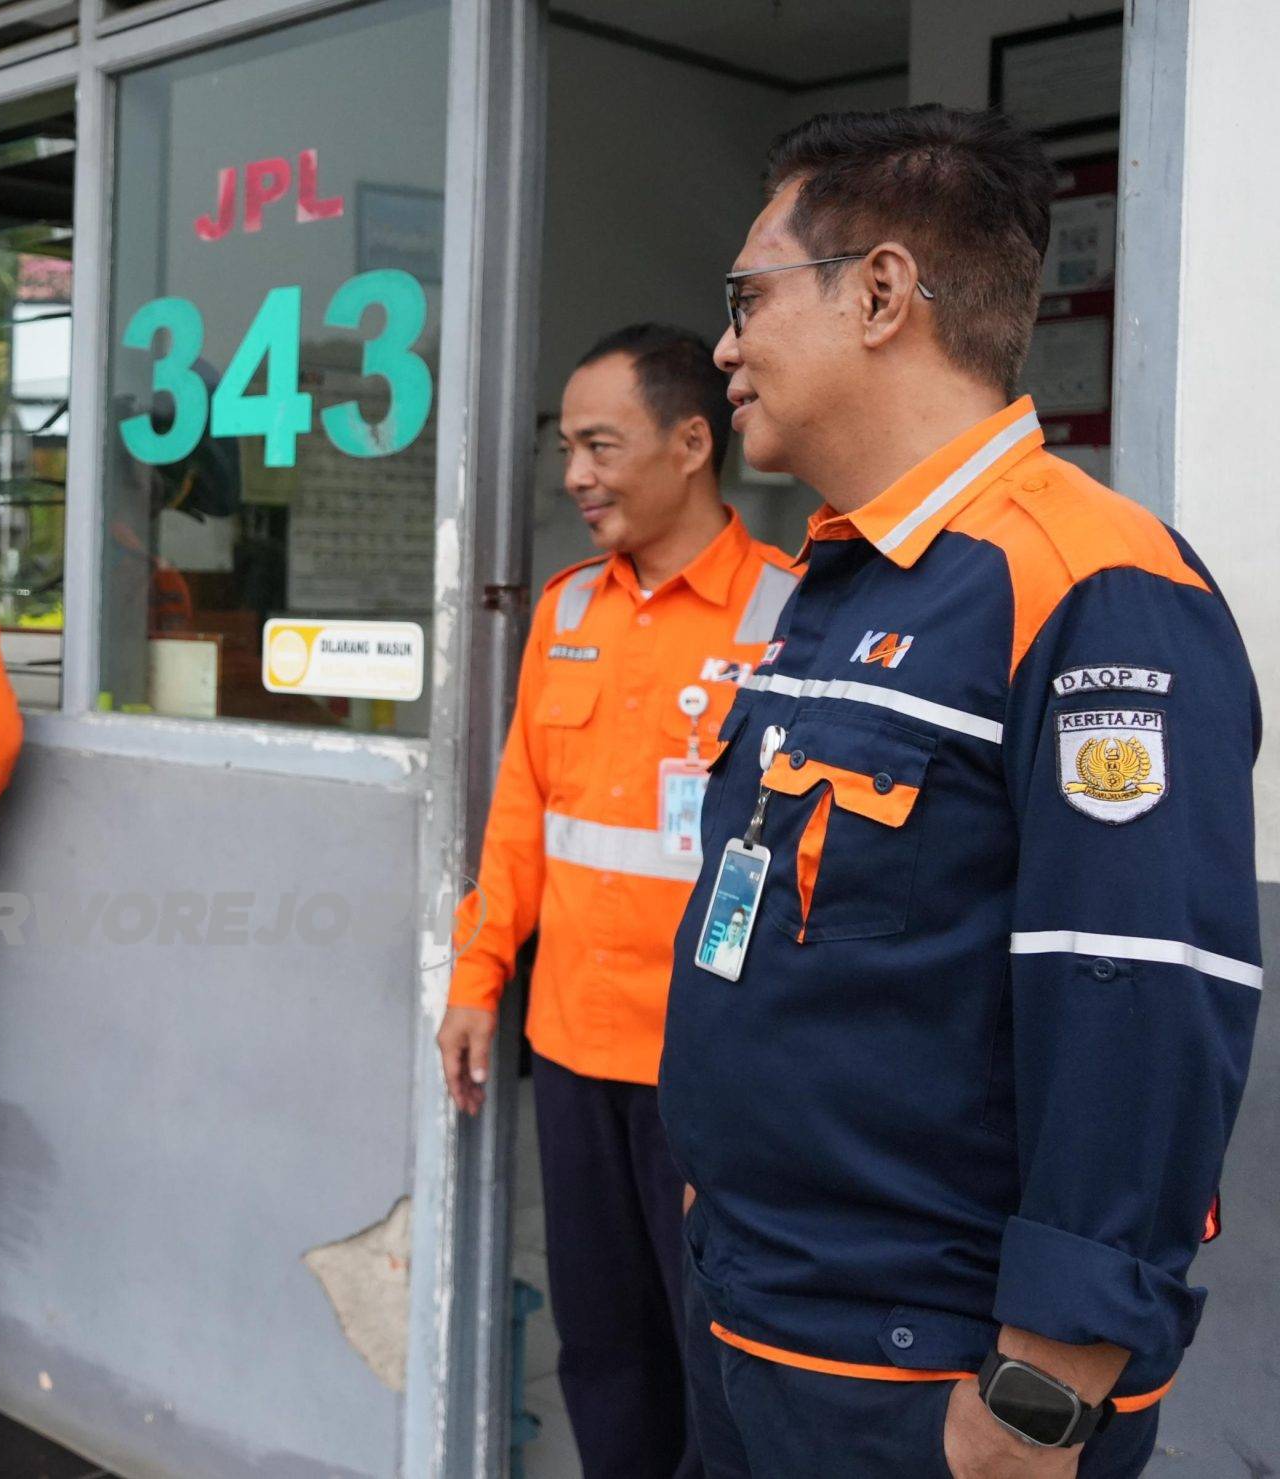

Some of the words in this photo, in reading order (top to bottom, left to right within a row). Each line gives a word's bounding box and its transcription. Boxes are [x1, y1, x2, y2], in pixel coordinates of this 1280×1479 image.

[194, 148, 344, 241] JPL
[119, 268, 433, 468] 343
[849, 630, 914, 668] KAI
[1147, 673, 1158, 688] 5
[1062, 712, 1125, 728] KERETA
[1131, 712, 1159, 727] API
